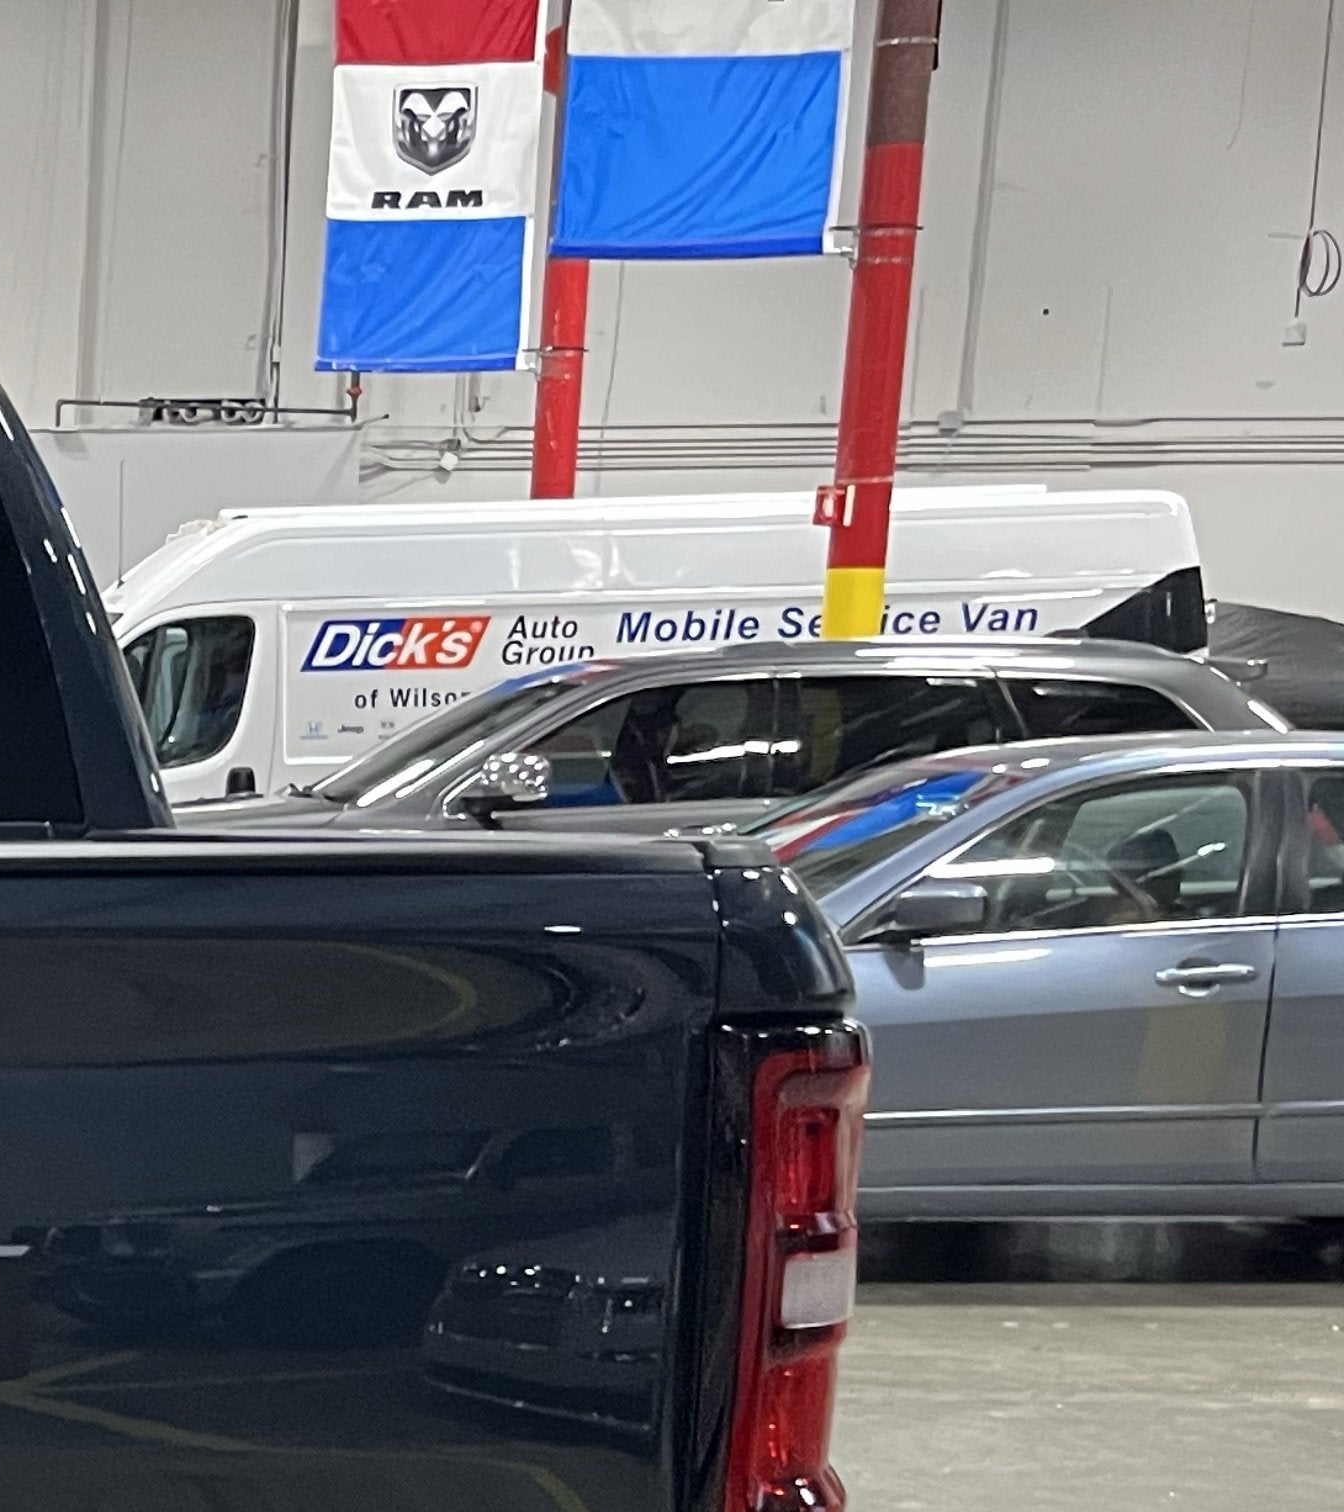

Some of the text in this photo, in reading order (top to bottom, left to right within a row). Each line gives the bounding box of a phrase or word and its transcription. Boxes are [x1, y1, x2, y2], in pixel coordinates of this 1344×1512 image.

[370, 190, 483, 209] RAM
[507, 615, 578, 640] Auto
[615, 602, 1040, 643] Mobile Seice Van
[311, 620, 474, 667] Dick's
[354, 687, 470, 709] of Wilso
